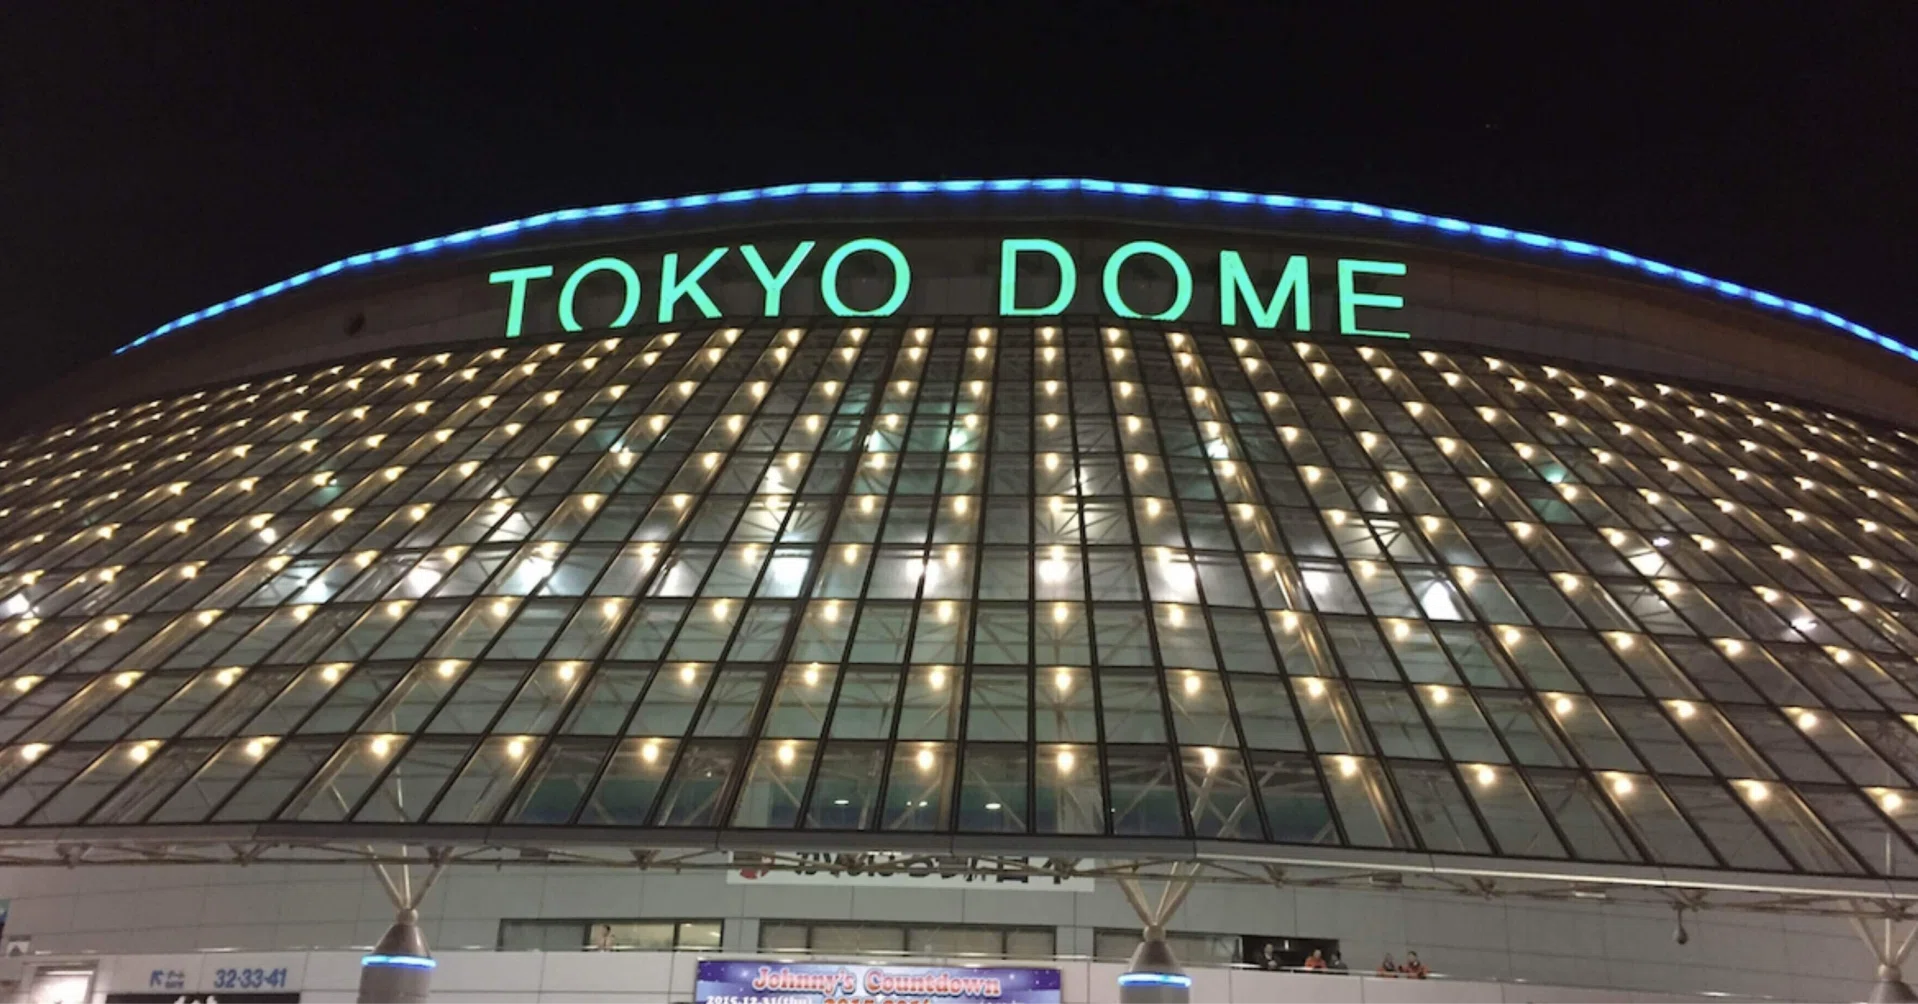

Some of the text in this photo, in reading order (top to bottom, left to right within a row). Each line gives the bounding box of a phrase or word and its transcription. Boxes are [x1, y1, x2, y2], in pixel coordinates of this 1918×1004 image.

[489, 238, 1410, 338] TOKYO DOME
[753, 967, 1001, 998] Johnny's Countdown
